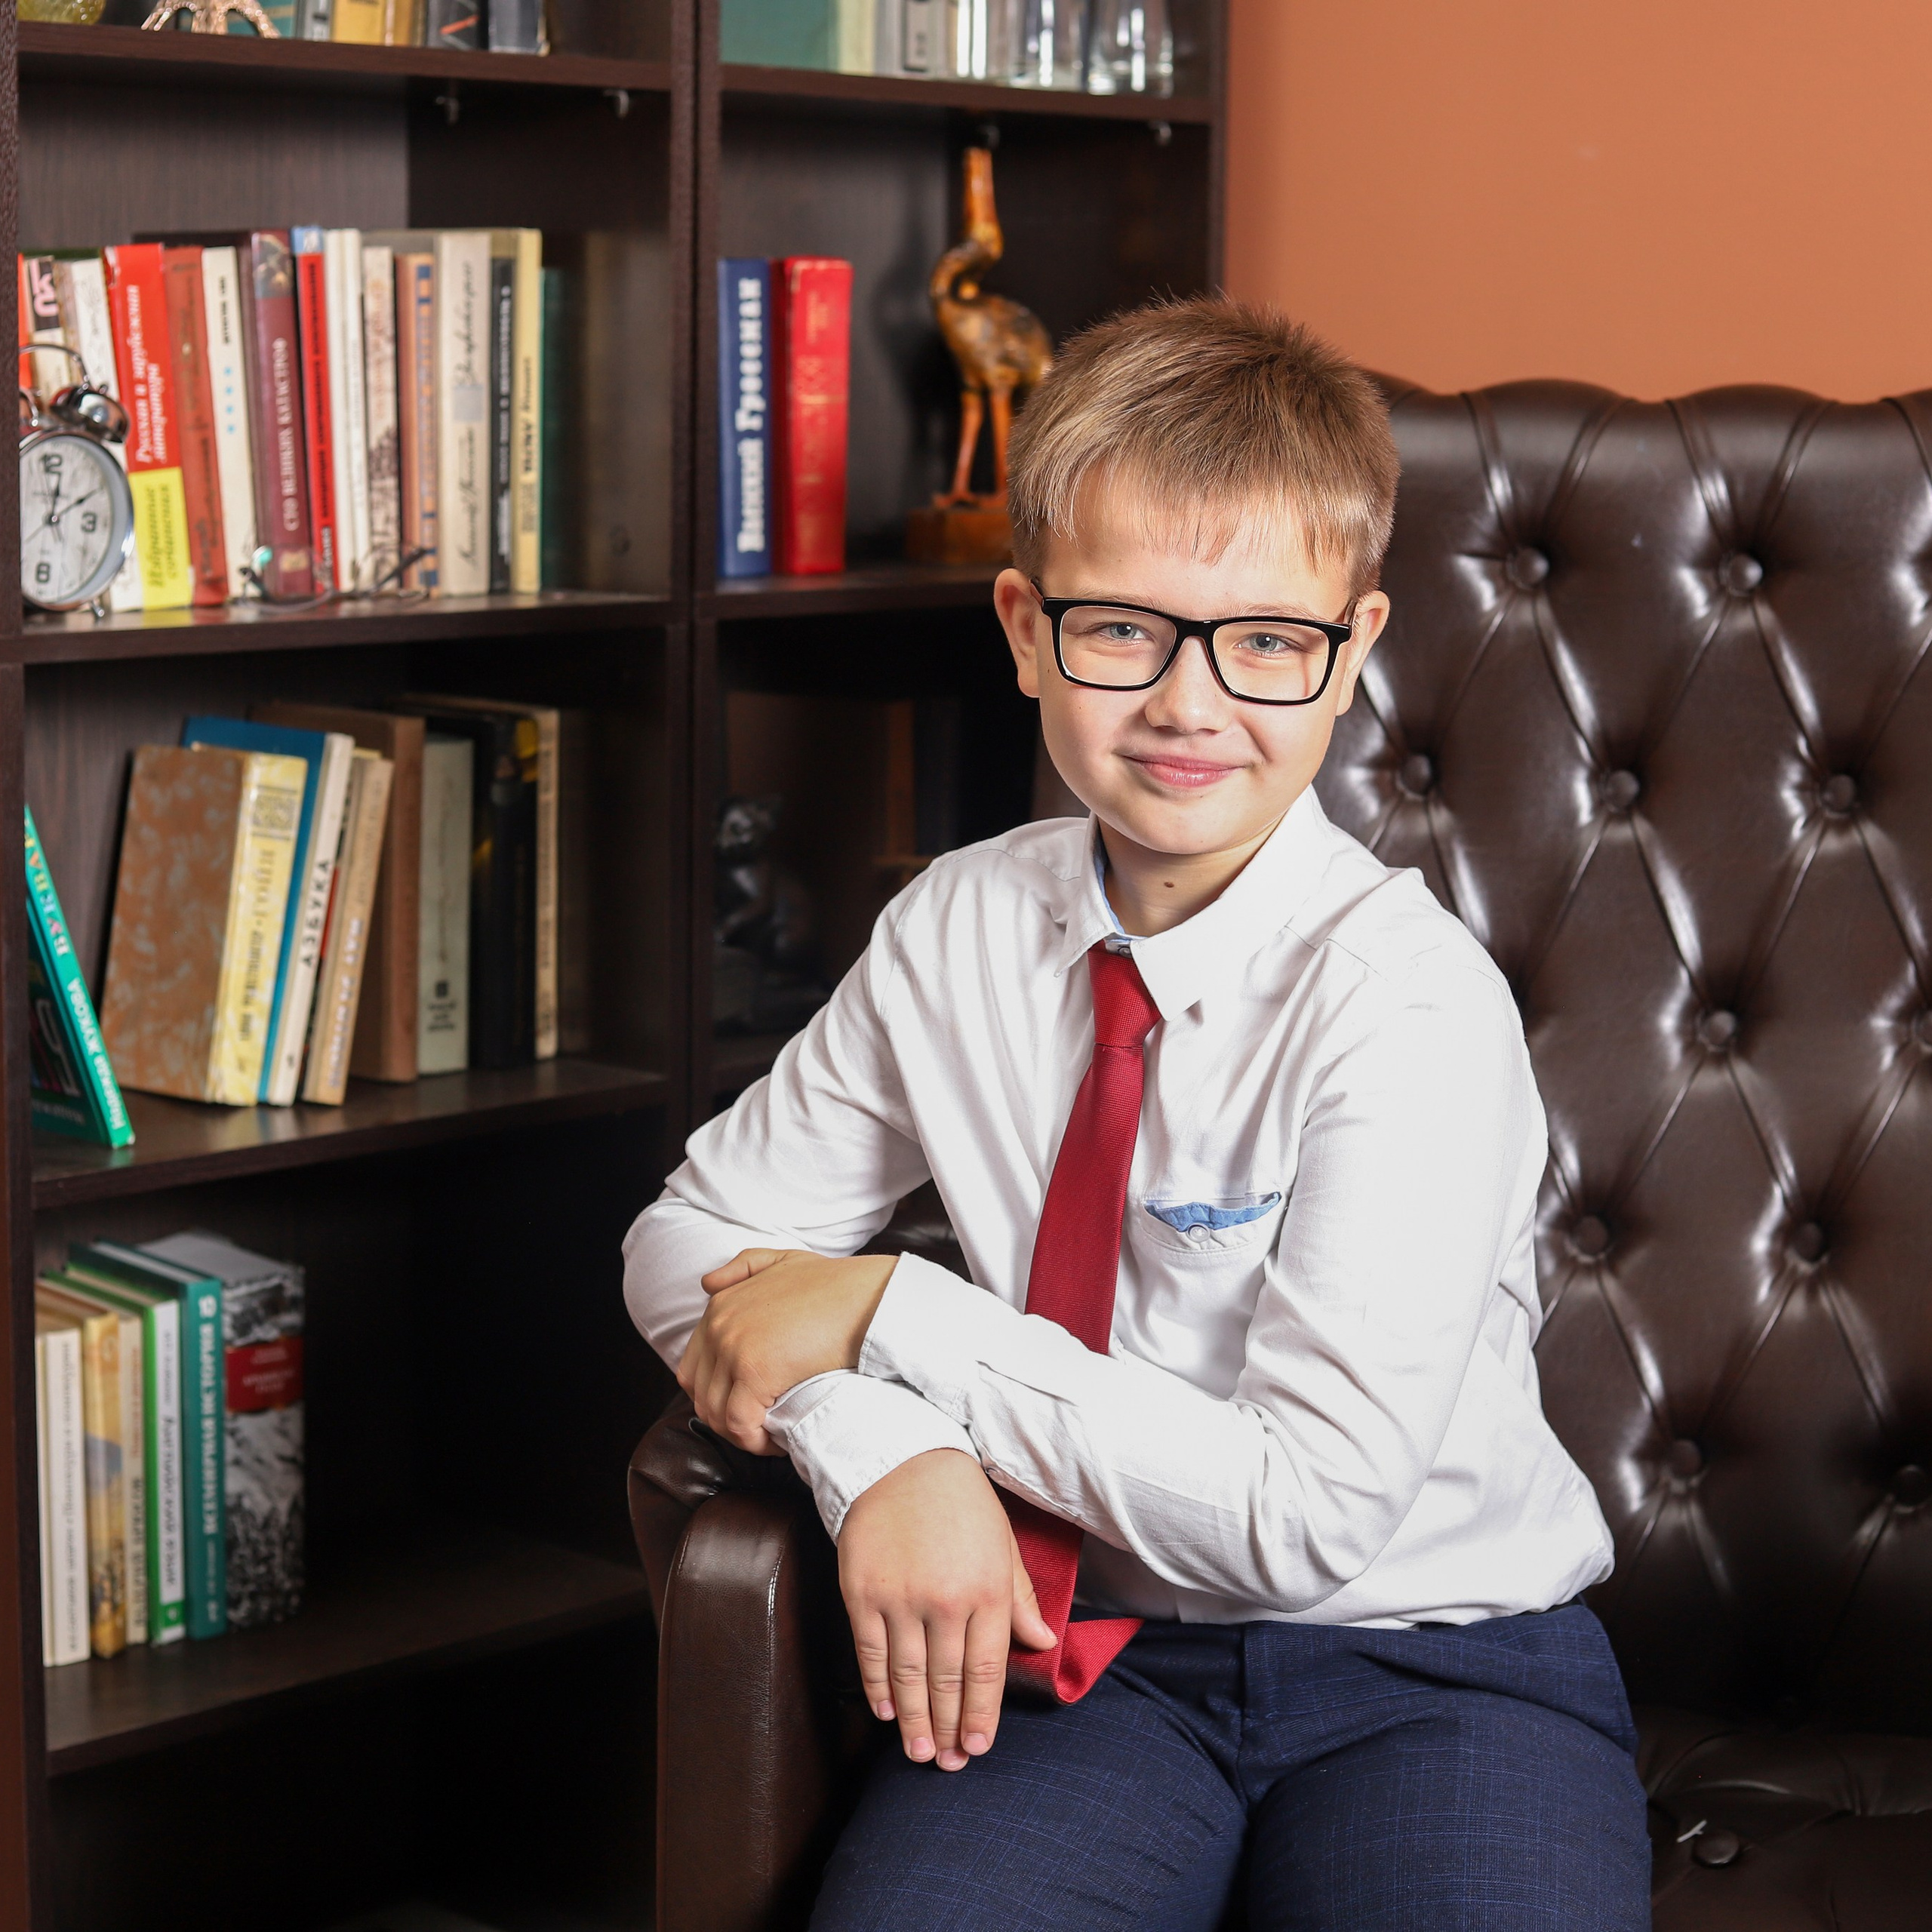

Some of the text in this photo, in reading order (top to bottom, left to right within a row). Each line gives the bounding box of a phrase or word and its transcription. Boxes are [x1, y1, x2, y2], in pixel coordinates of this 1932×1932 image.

[735, 278, 767, 432] Гроссман
[278, 426, 298, 496] ВЕЛИКИХ
[81, 512, 97, 534] 3
[282, 498, 301, 532] СТО
[300, 857, 333, 968] АЗБУКА
[66, 977, 102, 1055] ЖУКОВА
